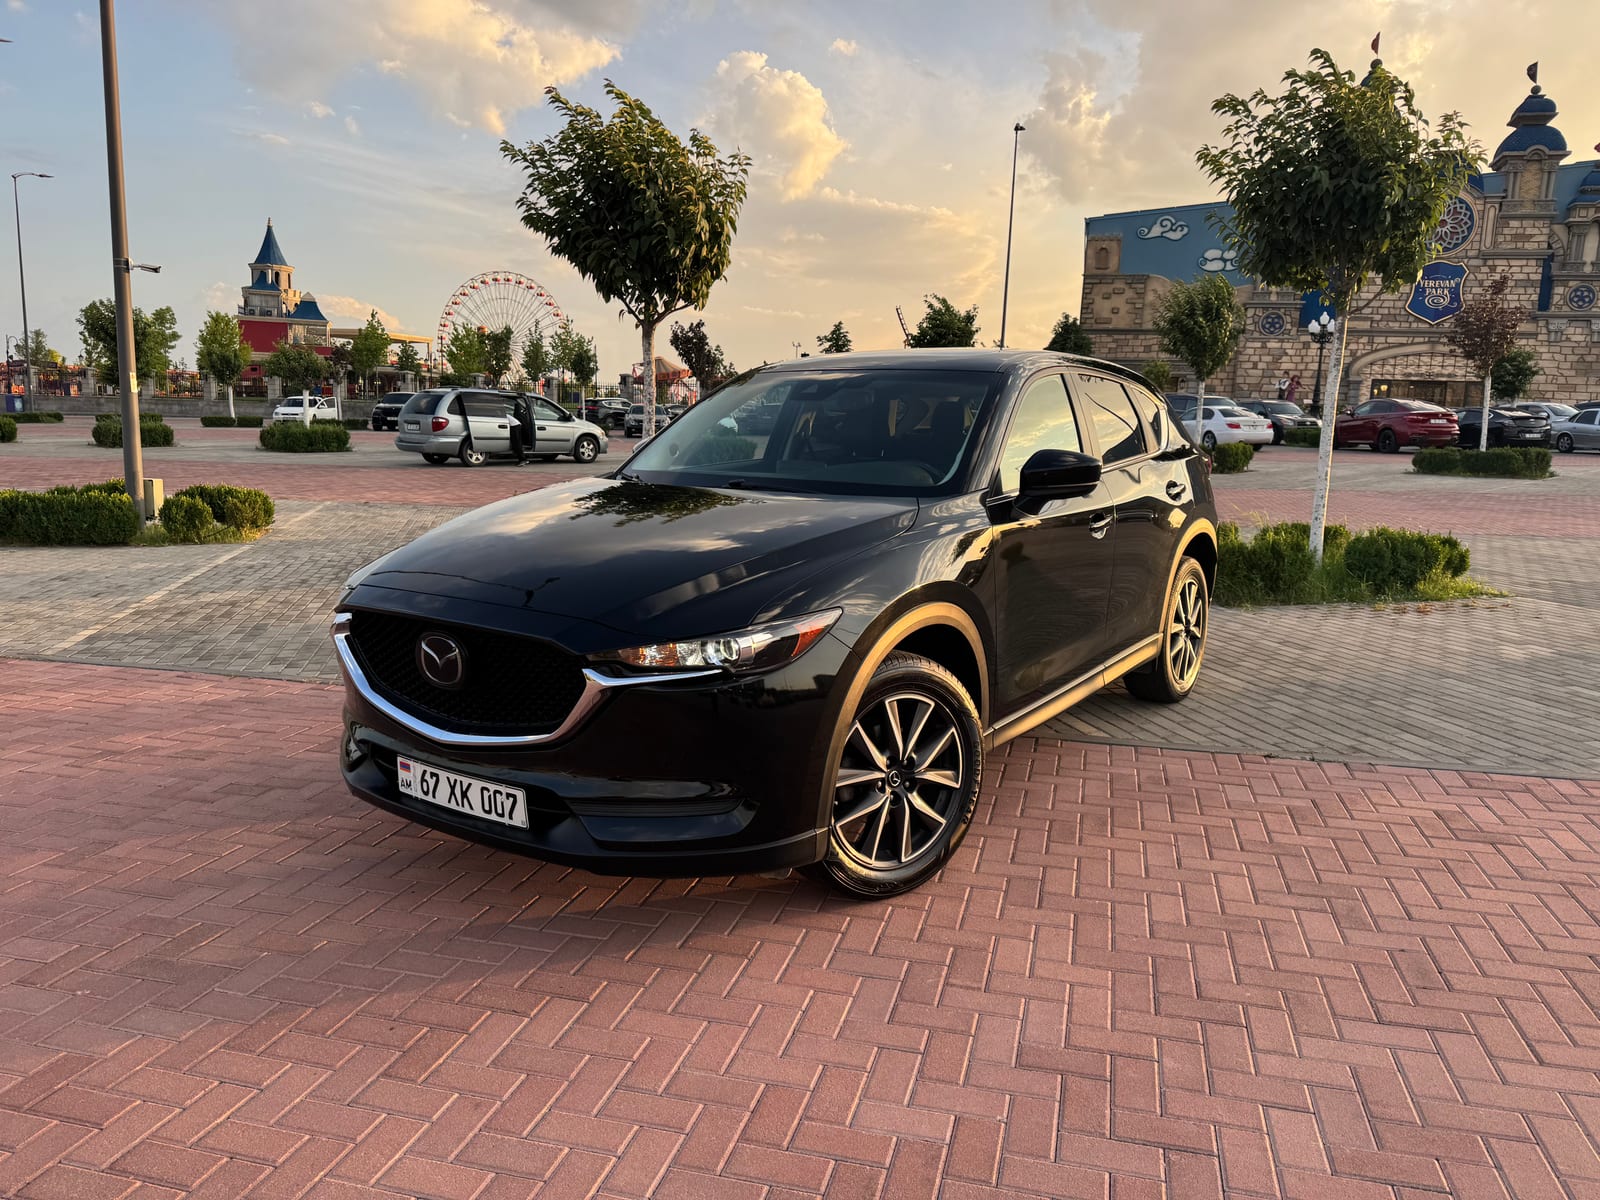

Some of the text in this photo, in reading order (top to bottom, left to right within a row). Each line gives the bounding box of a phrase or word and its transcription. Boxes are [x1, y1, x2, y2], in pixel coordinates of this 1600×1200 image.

[1420, 279, 1456, 288] YEREVAN
[1425, 287, 1449, 296] PARK
[420, 769, 518, 821] 67 XK 007
